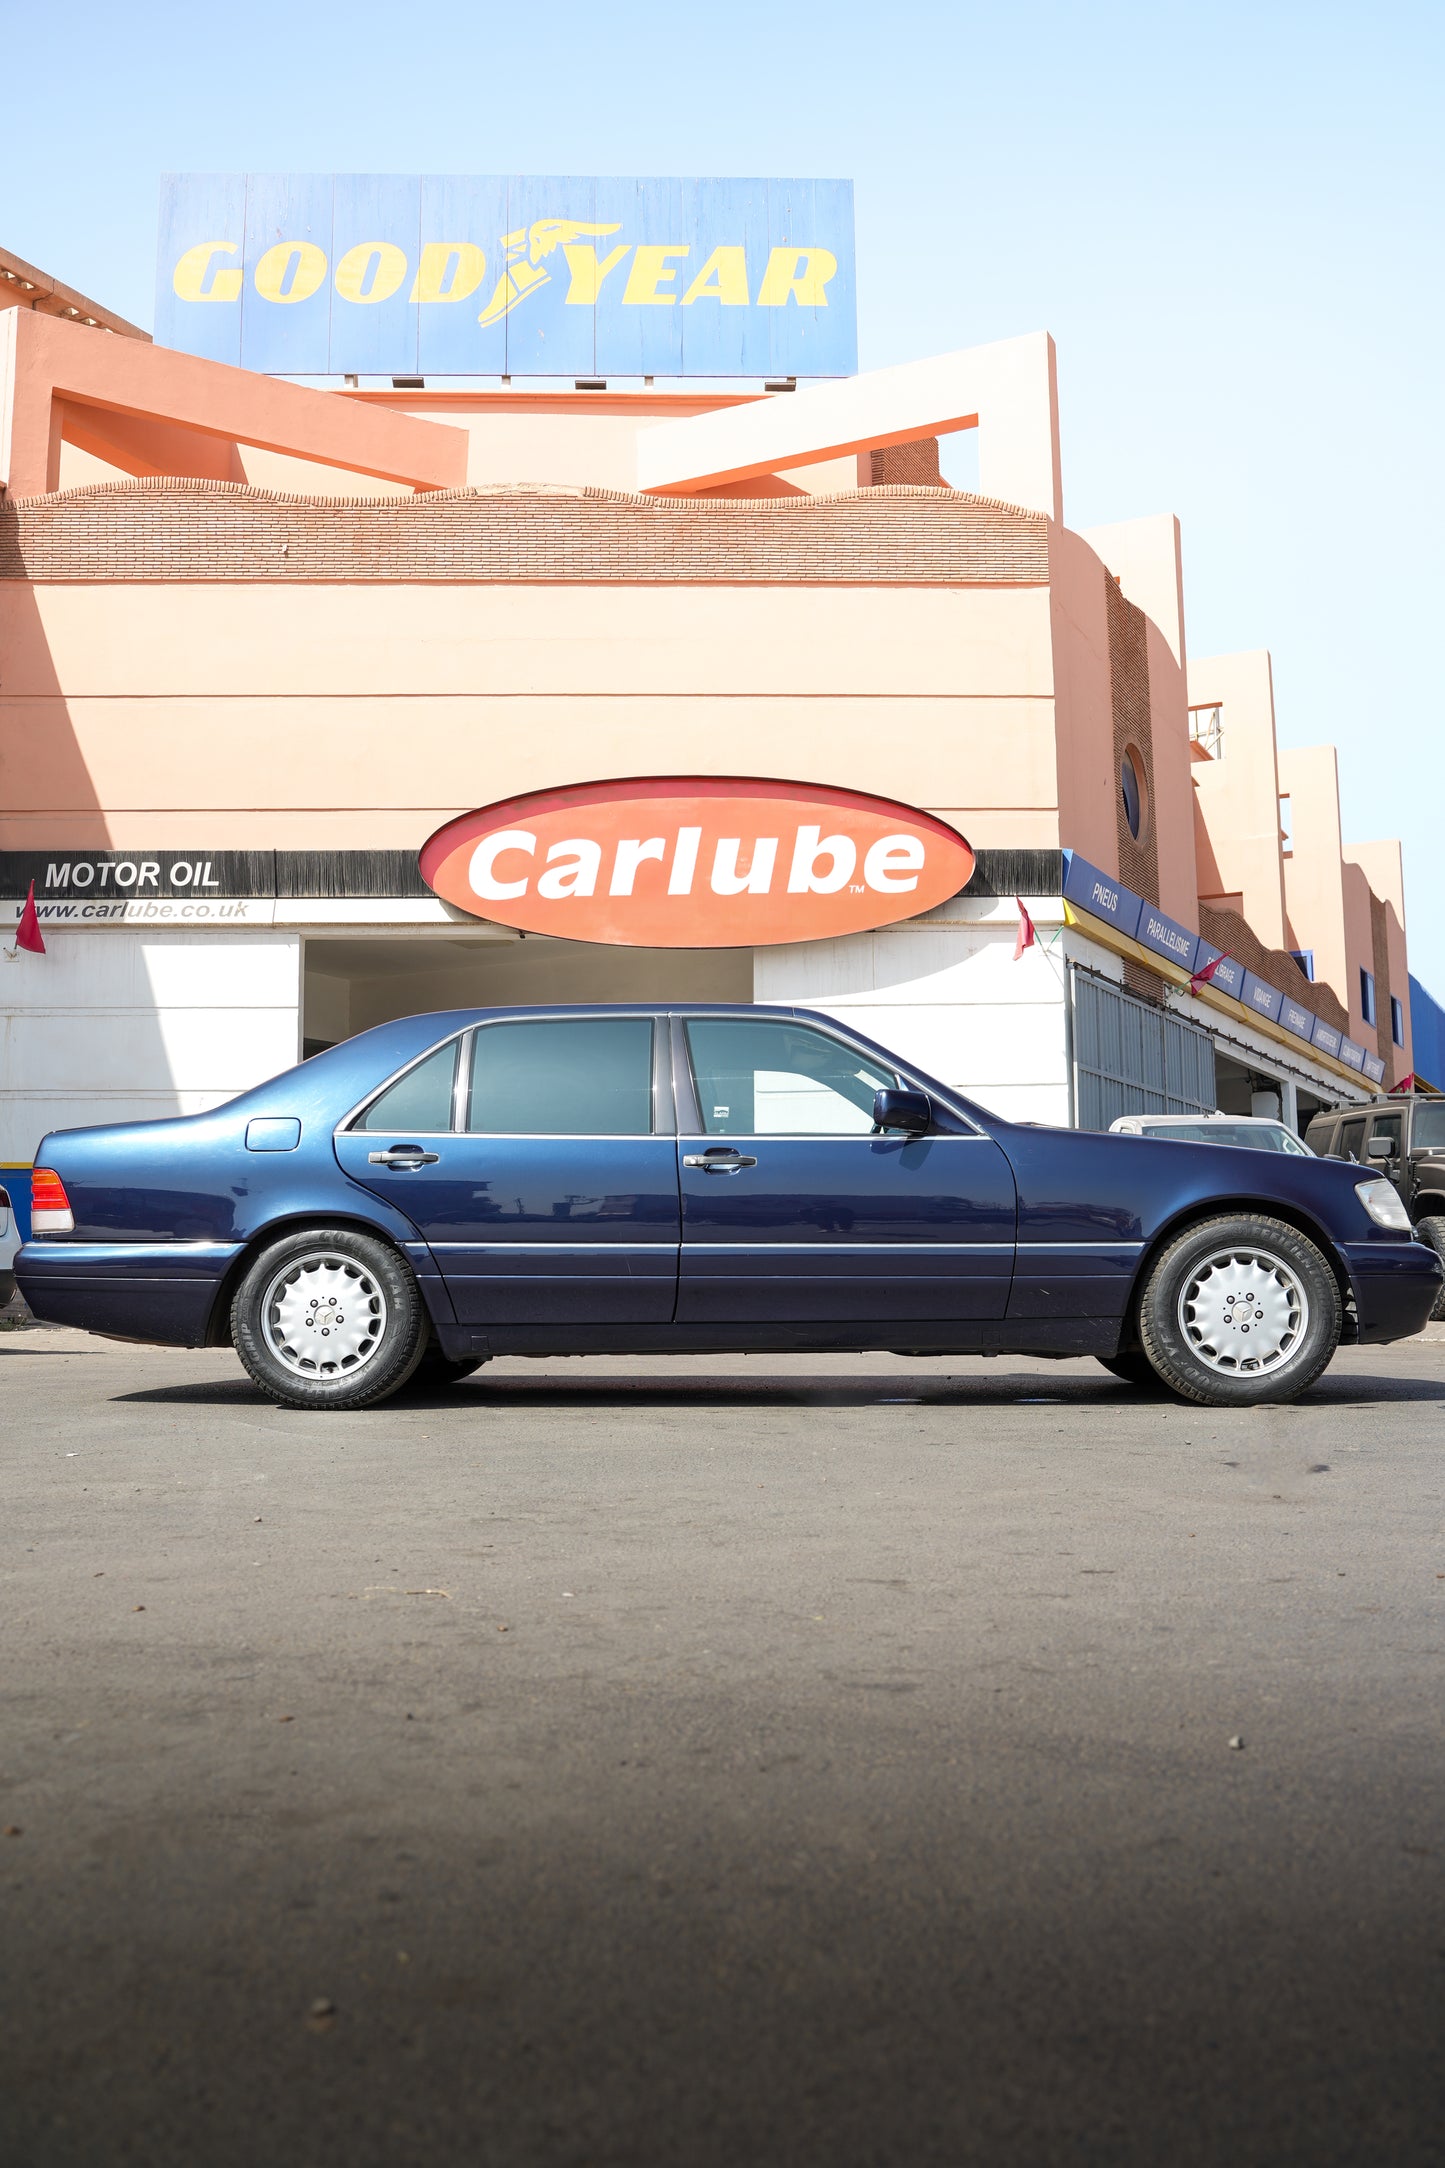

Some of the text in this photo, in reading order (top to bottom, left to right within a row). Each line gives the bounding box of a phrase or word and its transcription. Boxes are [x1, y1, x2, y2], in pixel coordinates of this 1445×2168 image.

[45, 861, 220, 888] MOTOR OIL
[468, 825, 925, 901] Carlube
[1092, 882, 1118, 912] PNEUS
[1146, 918, 1190, 957] PARALLELISME
[1206, 956, 1235, 984] ELIBRAGE
